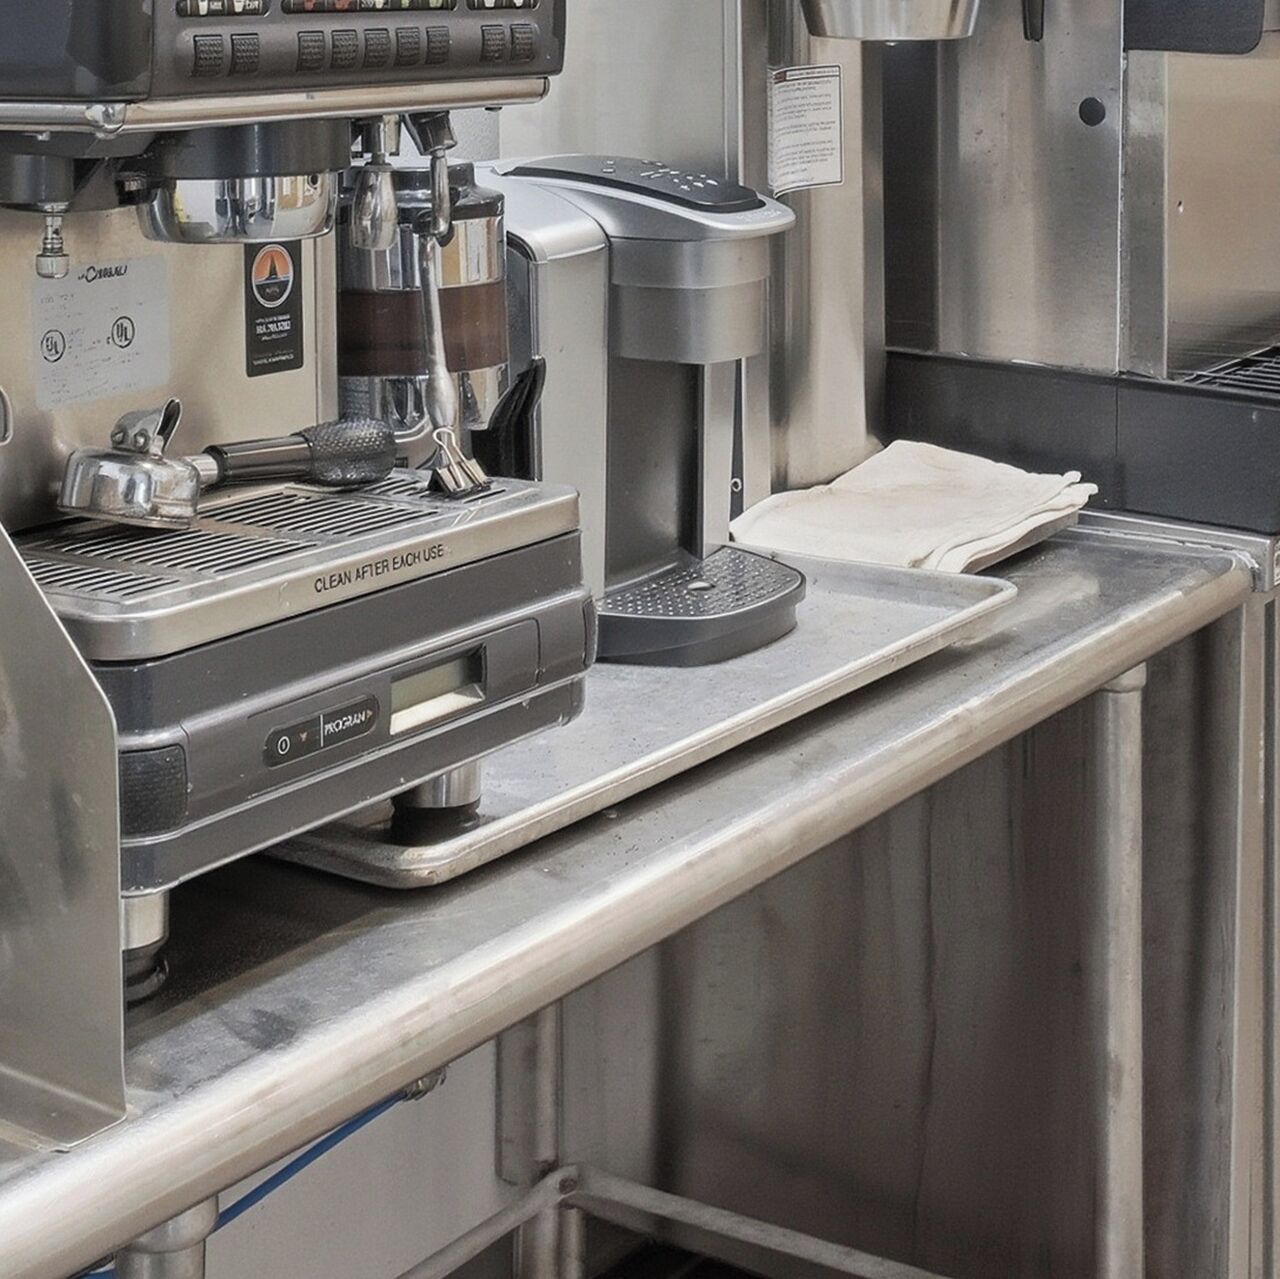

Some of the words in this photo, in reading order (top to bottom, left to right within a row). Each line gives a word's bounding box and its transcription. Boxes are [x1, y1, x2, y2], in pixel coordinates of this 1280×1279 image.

[314, 570, 352, 593] CLEAN
[355, 558, 390, 581] AFTER
[392, 551, 421, 571] EACH
[423, 544, 444, 562] USE
